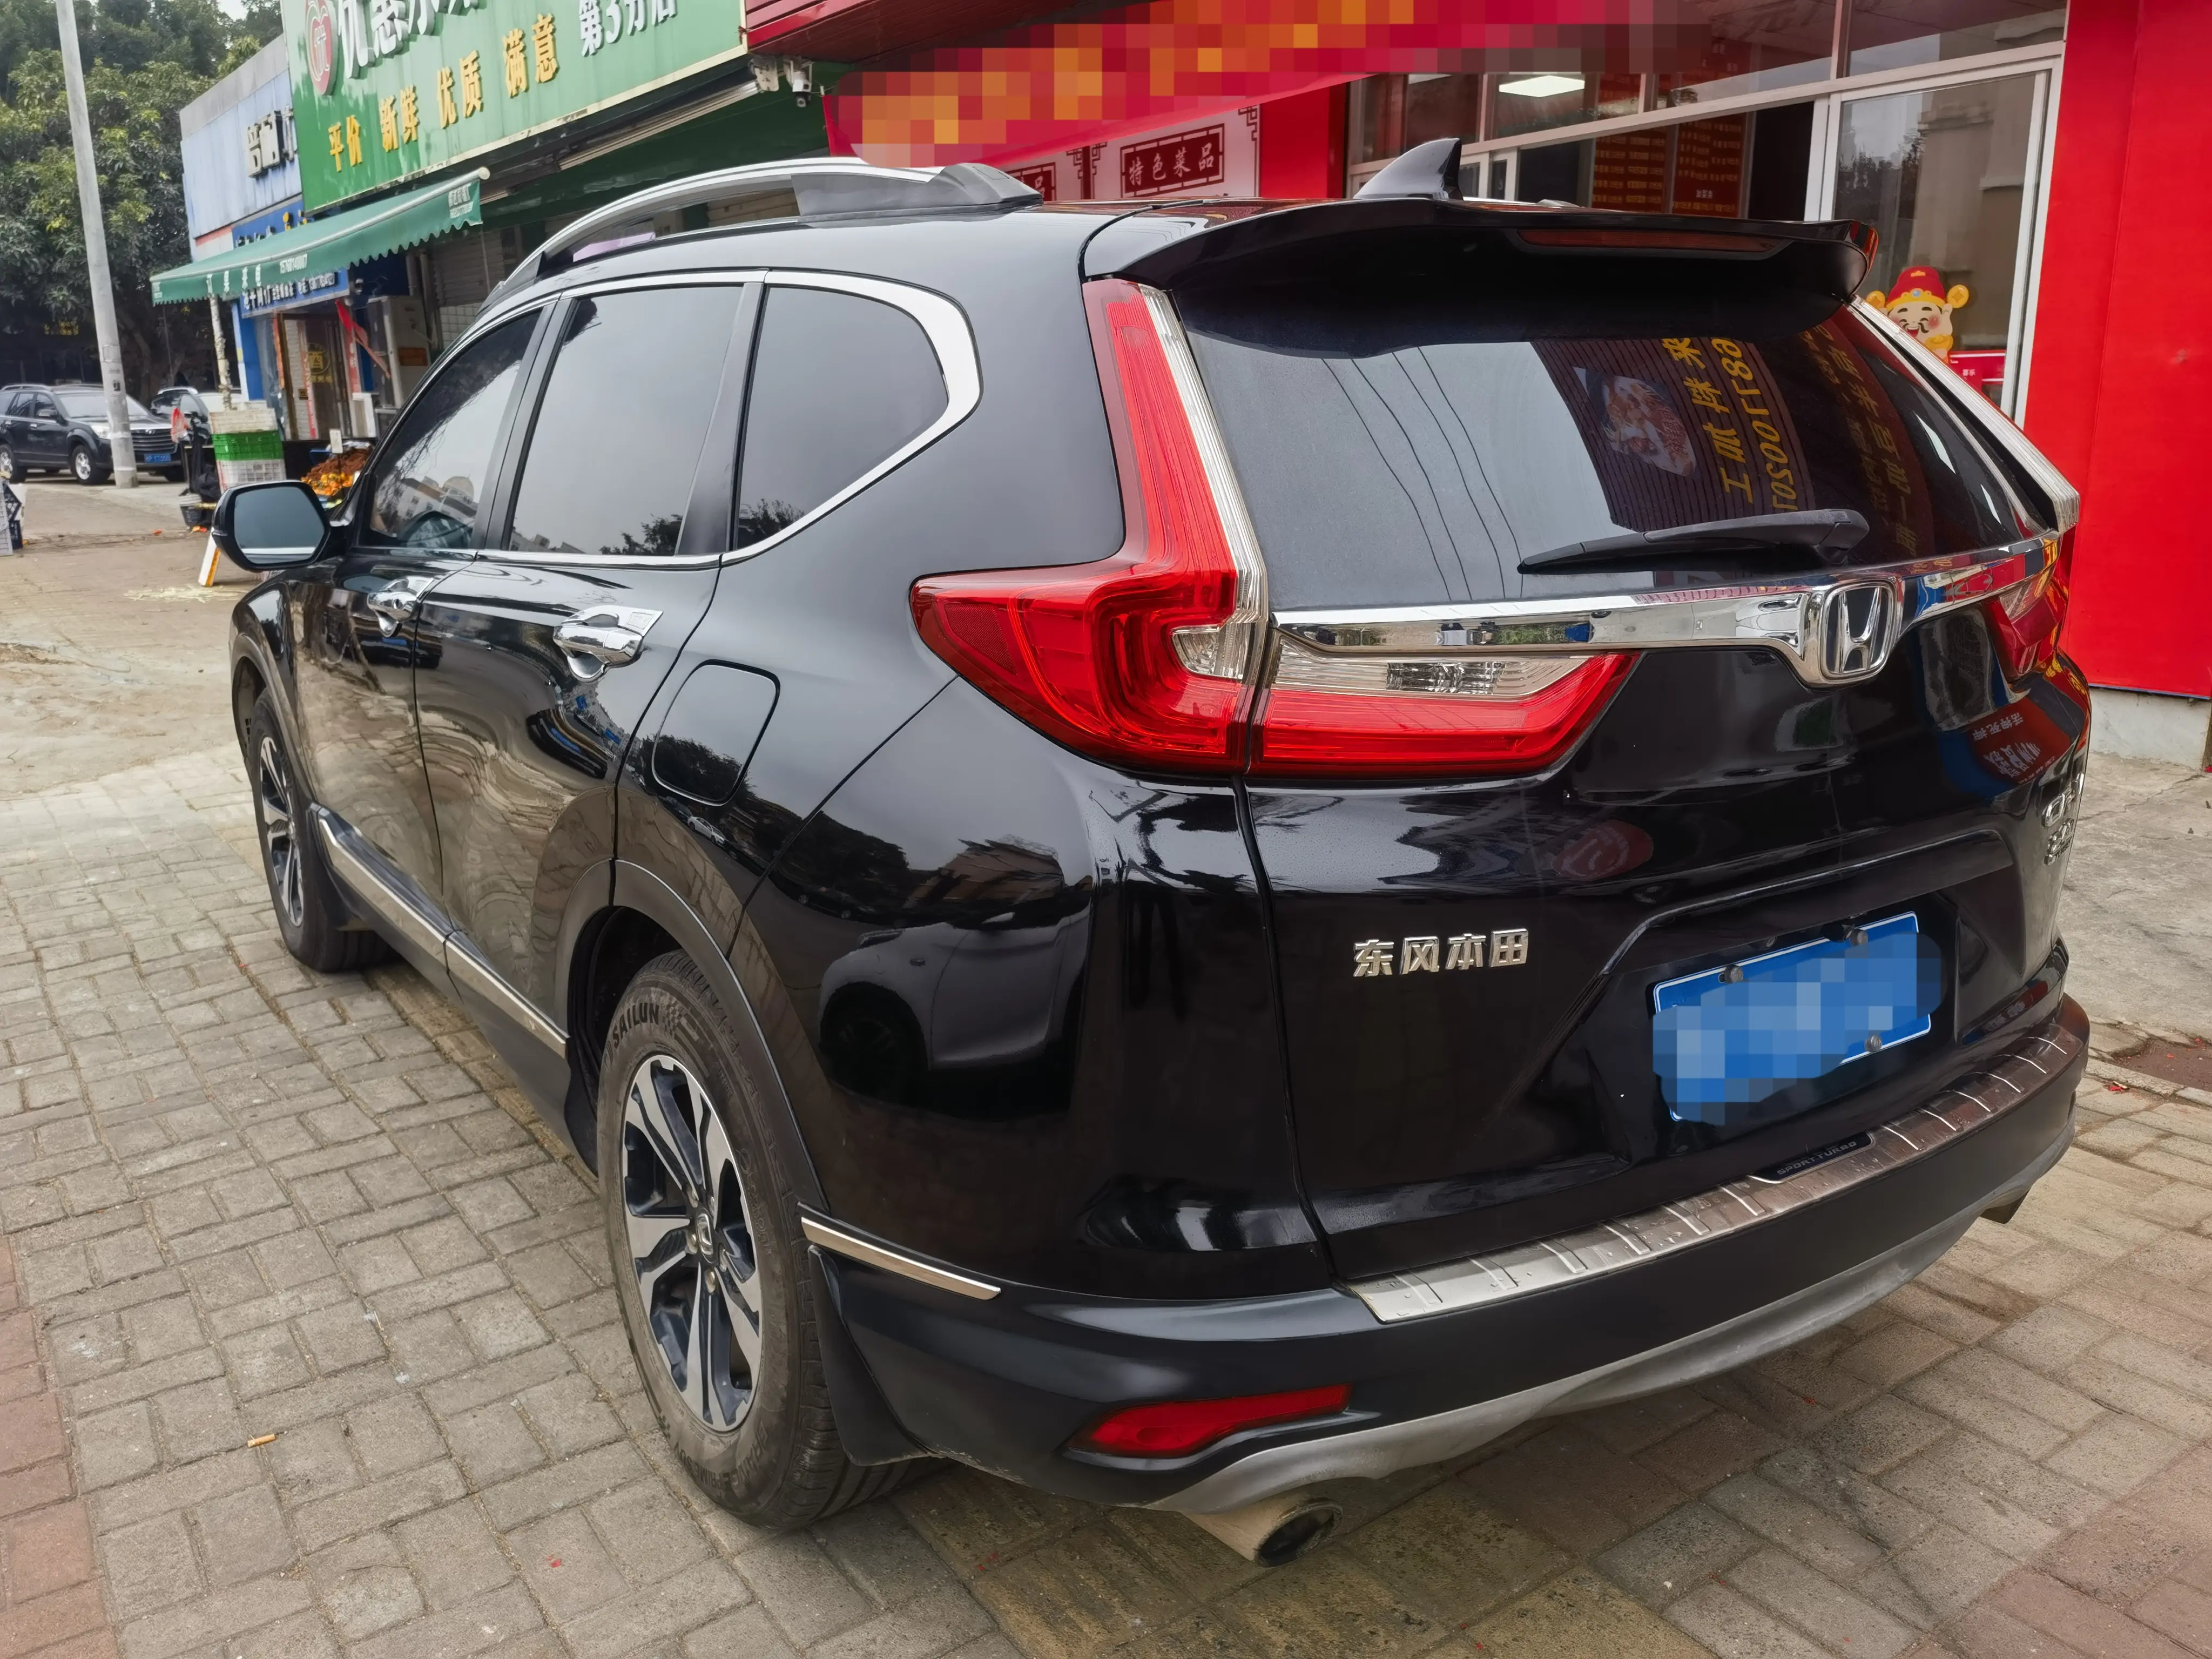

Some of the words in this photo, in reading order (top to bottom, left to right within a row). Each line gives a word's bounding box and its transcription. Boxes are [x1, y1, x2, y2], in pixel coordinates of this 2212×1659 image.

[328, 115, 363, 172] 平价
[380, 85, 420, 153] 新鲜
[436, 50, 484, 130] 优质
[503, 14, 559, 99] 满意
[1128, 142, 1215, 186] 特色菜品
[1353, 928, 1529, 977] 东风本田
[612, 1002, 659, 1049] SAILUN
